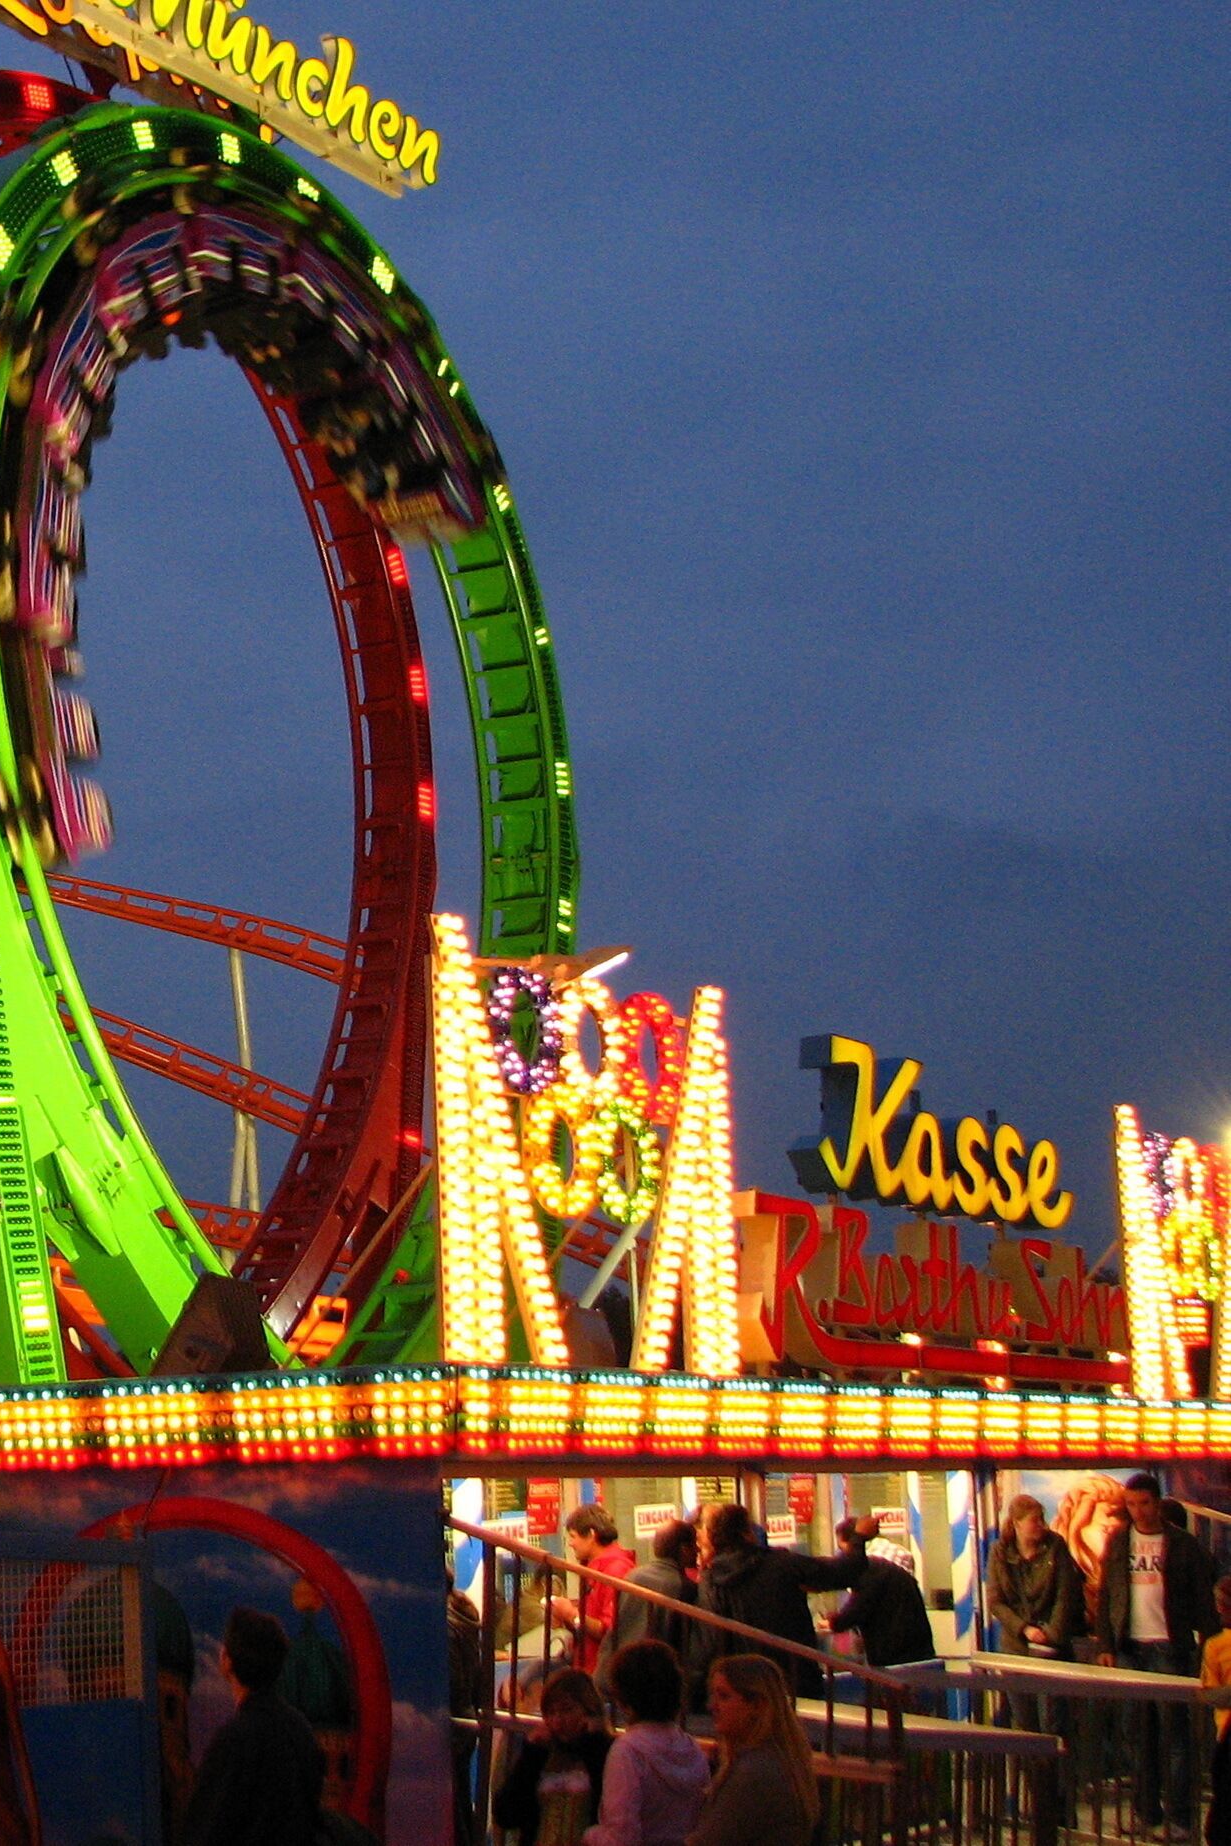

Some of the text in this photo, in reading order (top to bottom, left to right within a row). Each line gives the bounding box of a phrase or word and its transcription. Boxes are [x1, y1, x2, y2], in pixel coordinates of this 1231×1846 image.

[817, 1033, 1074, 1229] Kasse
[832, 1205, 984, 1334] Barth
[1020, 1238, 1131, 1349] Sohn
